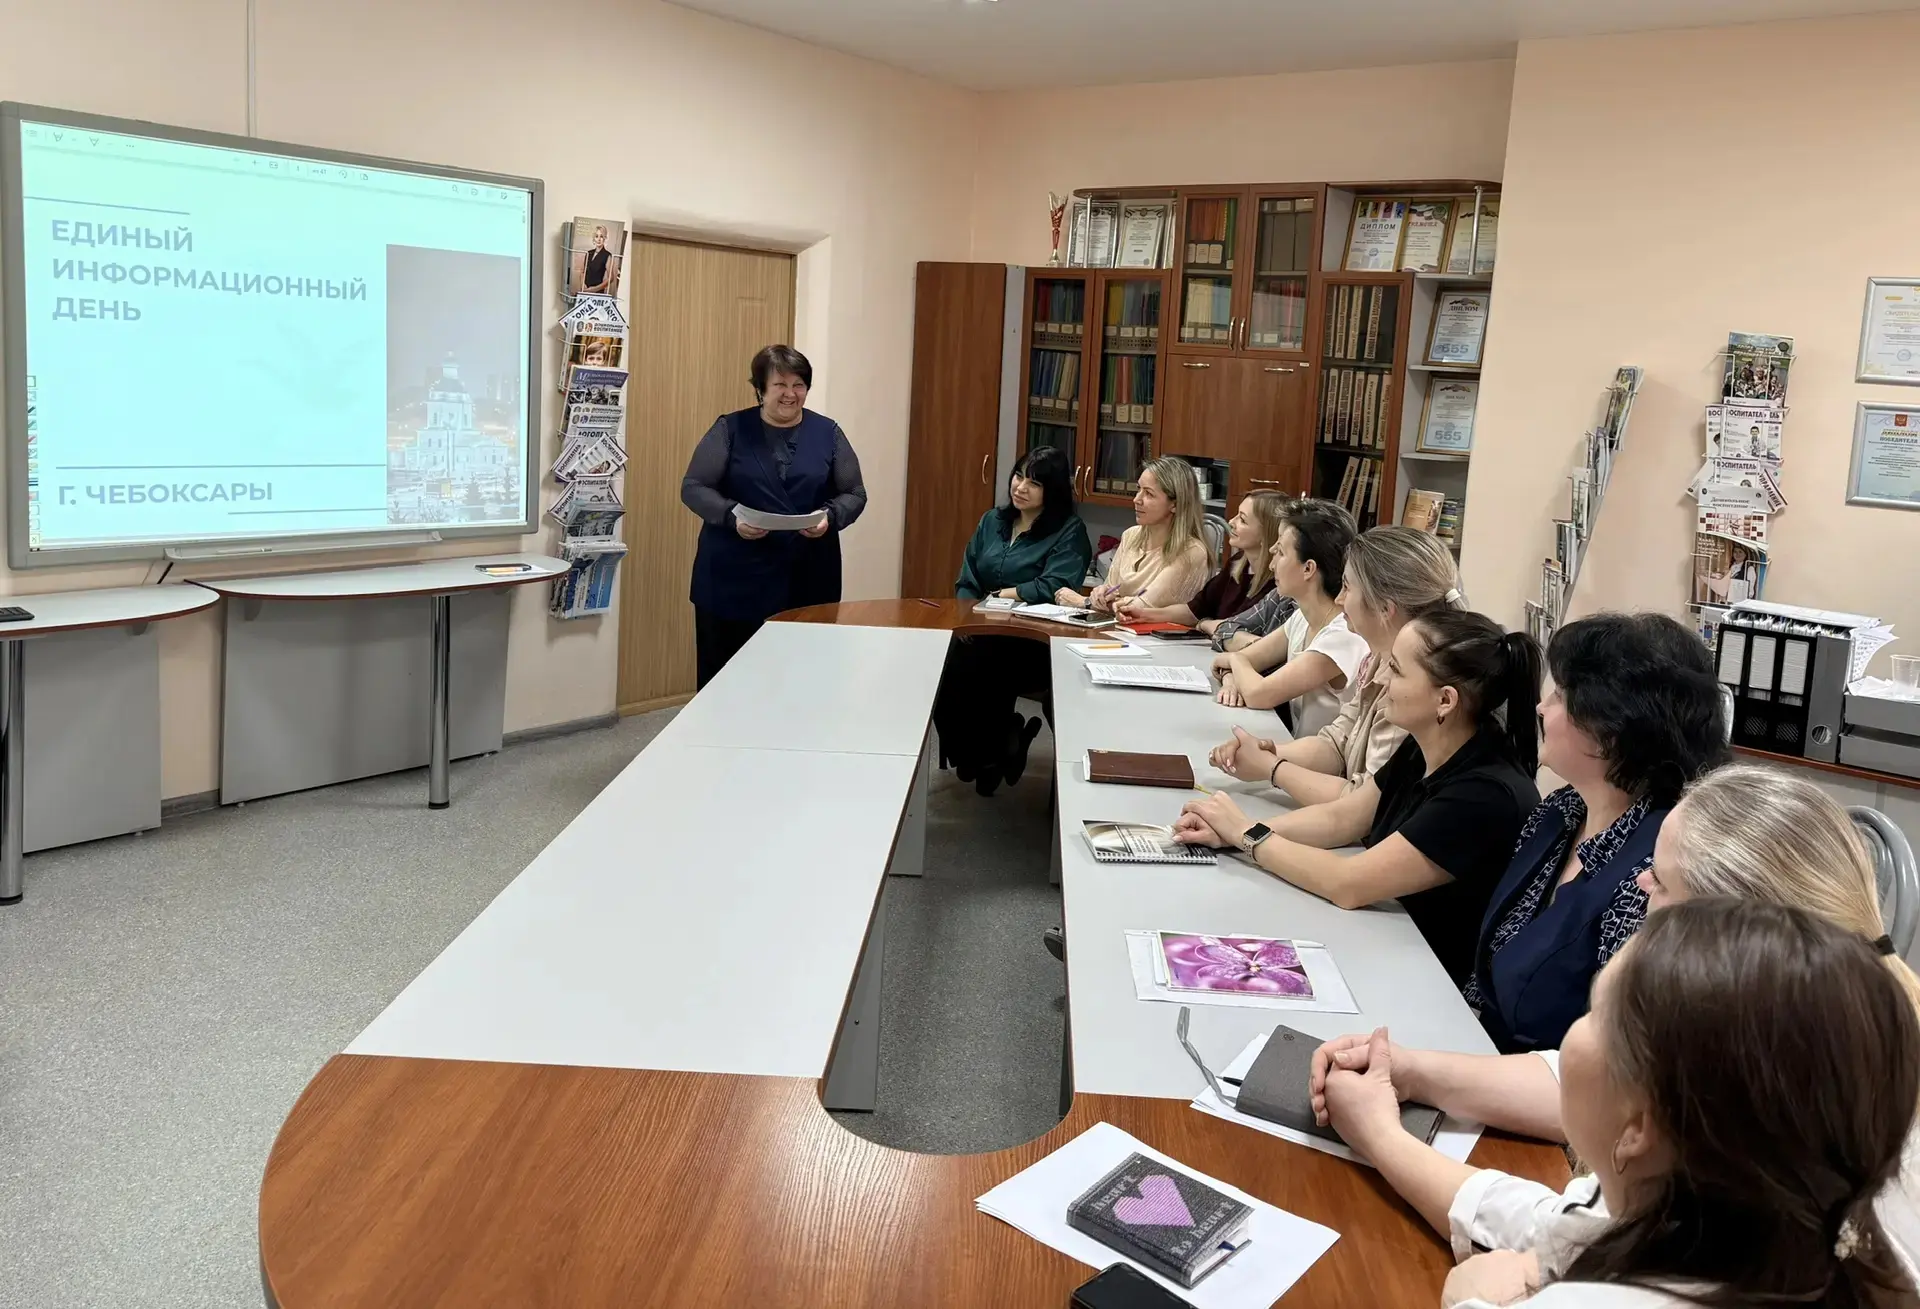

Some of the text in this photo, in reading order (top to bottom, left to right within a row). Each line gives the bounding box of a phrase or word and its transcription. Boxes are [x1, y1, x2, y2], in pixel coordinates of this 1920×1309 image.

[52, 220, 193, 252] ЕДИНЫЙ
[53, 258, 367, 301] ИНФОРМАЦИОННЫЙ
[52, 297, 141, 321] ДЕНЬ
[59, 482, 272, 506] Г. ЧЕБОКСАРЫ
[1090, 1175, 1138, 1210] heart
[1190, 1200, 1235, 1240] heart
